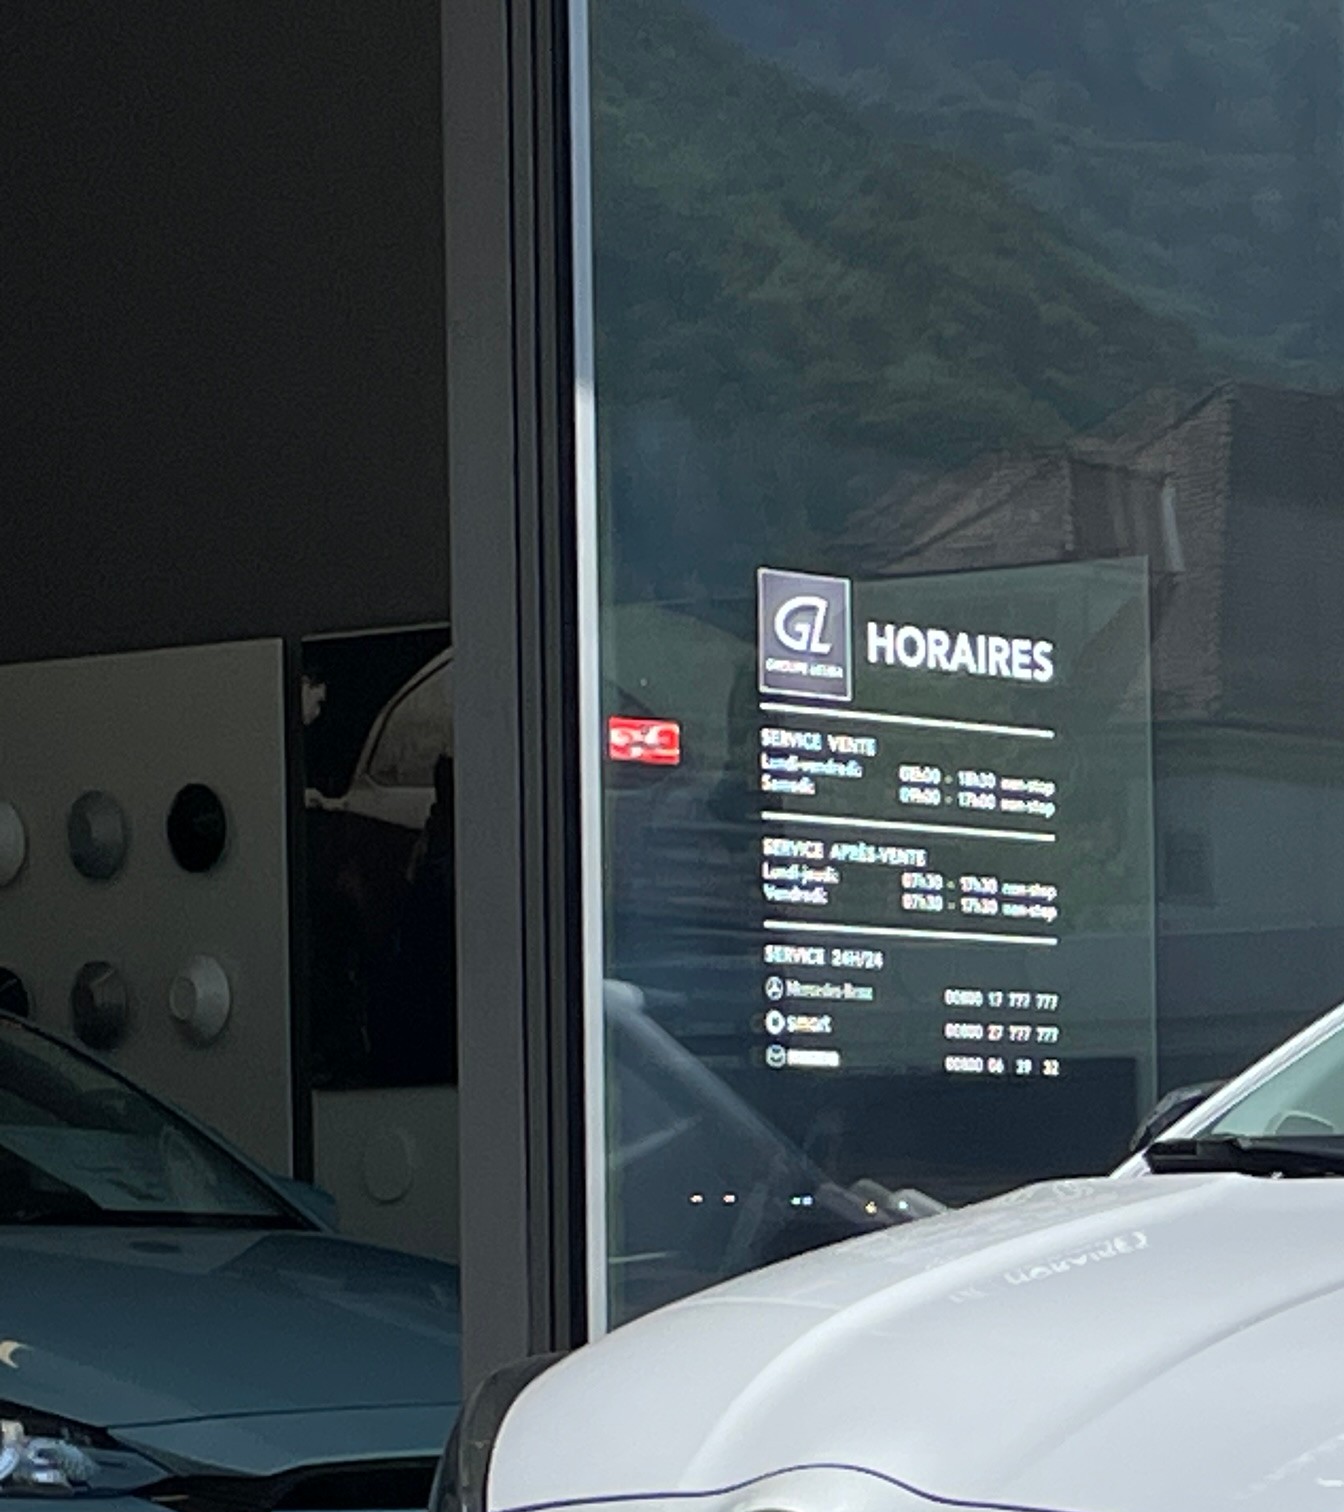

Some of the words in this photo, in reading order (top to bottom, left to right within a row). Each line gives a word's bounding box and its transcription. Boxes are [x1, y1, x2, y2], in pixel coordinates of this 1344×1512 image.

[773, 595, 833, 655] GL
[865, 620, 1055, 683] HORAIRES
[761, 728, 822, 750] SERVICE
[827, 734, 876, 756] VENTE
[763, 838, 824, 859] SERVICE
[764, 945, 825, 965] SERVICE
[832, 949, 884, 969] 24H/24
